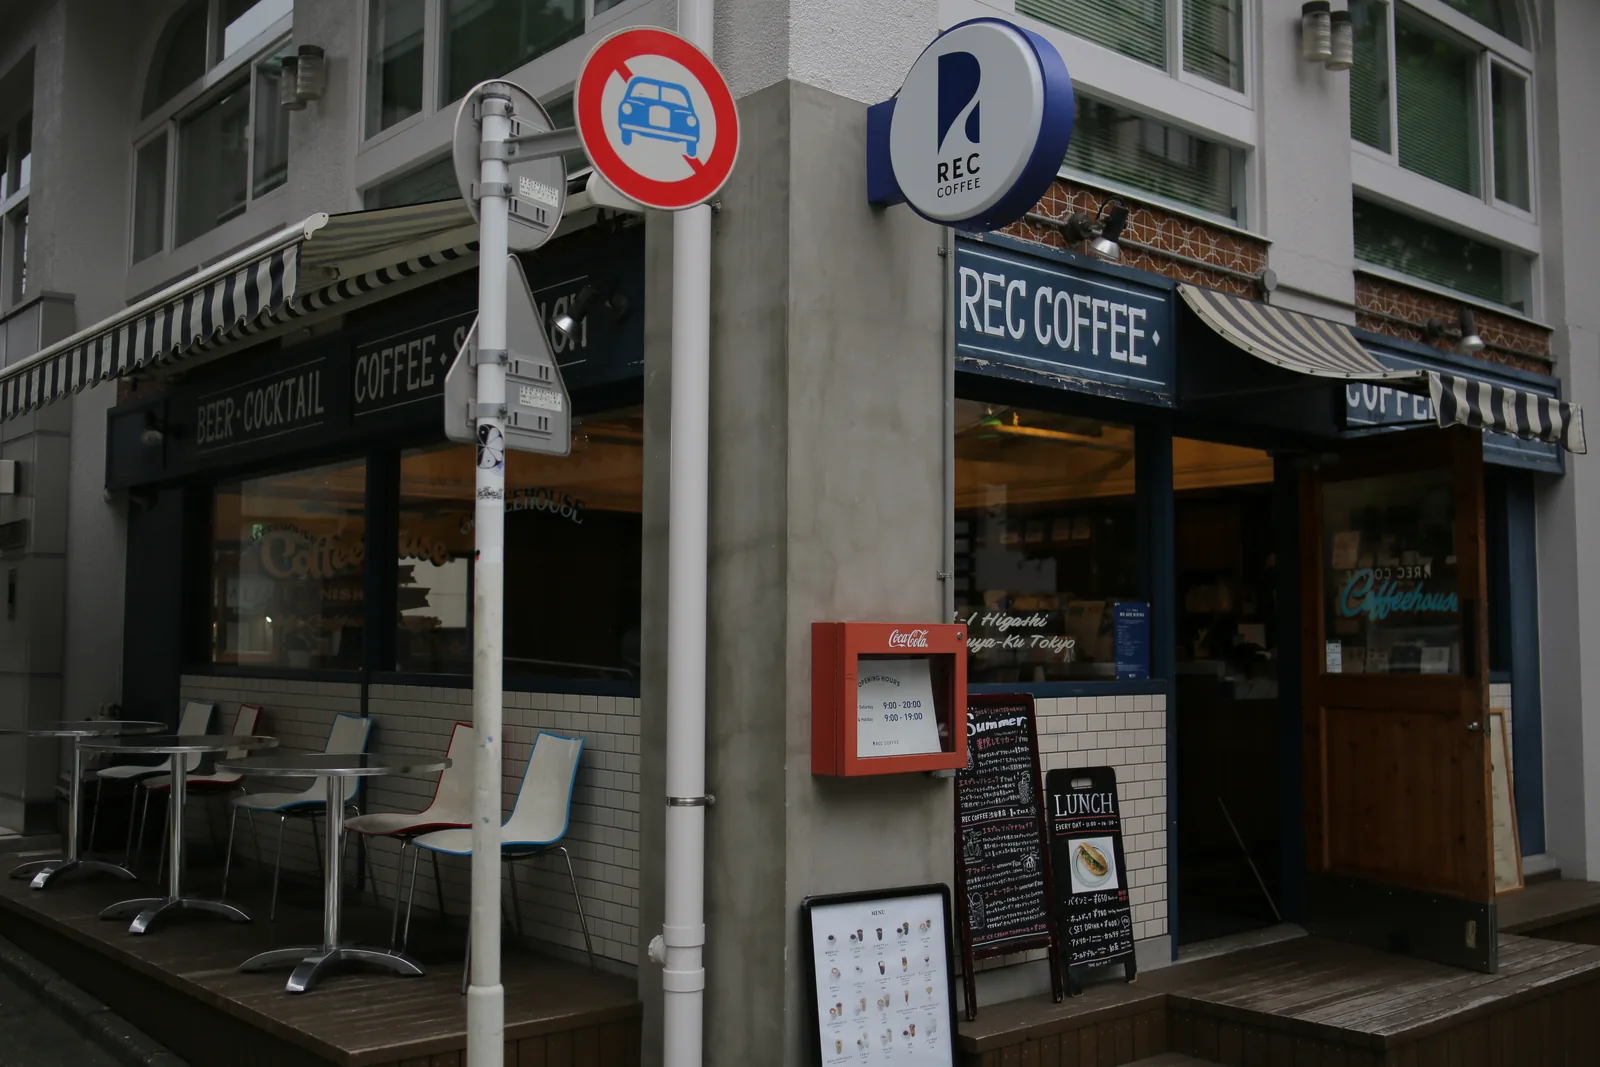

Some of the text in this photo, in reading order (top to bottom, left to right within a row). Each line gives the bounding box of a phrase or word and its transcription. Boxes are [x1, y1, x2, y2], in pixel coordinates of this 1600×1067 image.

[937, 153, 980, 183] REC
[937, 178, 980, 198] COFFEE
[959, 266, 1147, 366] REC COFFEE
[355, 334, 436, 403] COFFEE
[243, 370, 324, 432] COCKTAIL
[981, 612, 1049, 632] Higashi
[1030, 634, 1076, 653] Tokyo
[857, 676, 900, 688] OPENING HOURS
[883, 701, 897, 709] 9:00
[902, 700, 921, 708] 20:00
[884, 714, 898, 722] 9:00
[904, 712, 922, 720] 19:00
[1054, 792, 1114, 816] LUNCH
[962, 814, 971, 824] REC
[972, 812, 988, 822] COFFEE
[1056, 822, 1072, 831] EVERY
[1093, 894, 1108, 904] ¥650
[1010, 927, 1030, 935] TOPPING
